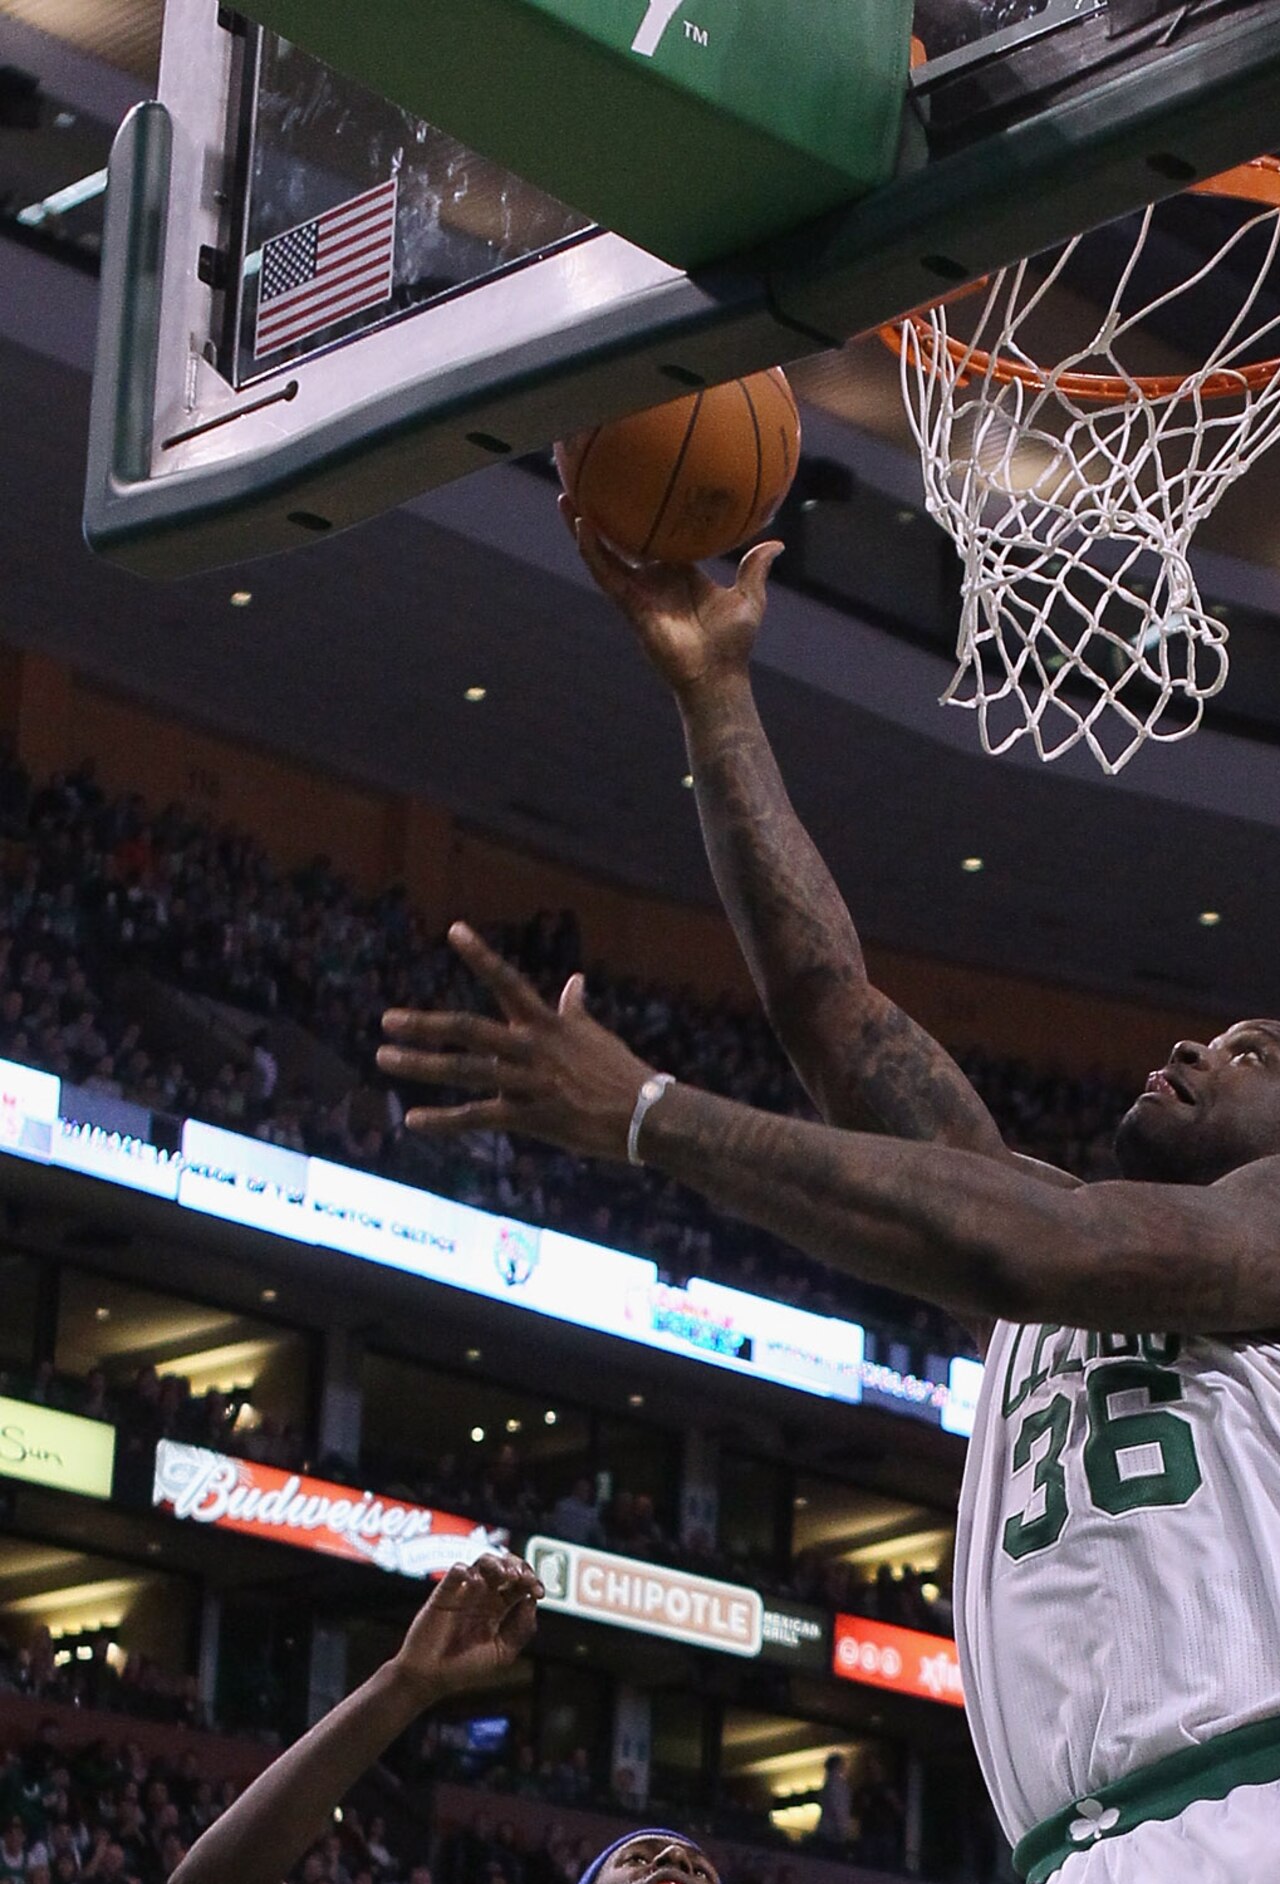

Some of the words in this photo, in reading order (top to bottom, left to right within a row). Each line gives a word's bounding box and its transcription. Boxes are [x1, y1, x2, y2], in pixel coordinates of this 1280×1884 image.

[0, 1425, 64, 1467] Sun
[1002, 1360, 1204, 1566] 36
[168, 1460, 433, 1524] Budweiser
[580, 1566, 749, 1635] CHIPOTLE
[762, 1610, 822, 1641] MEXICAN
[761, 1624, 801, 1648] GRILL
